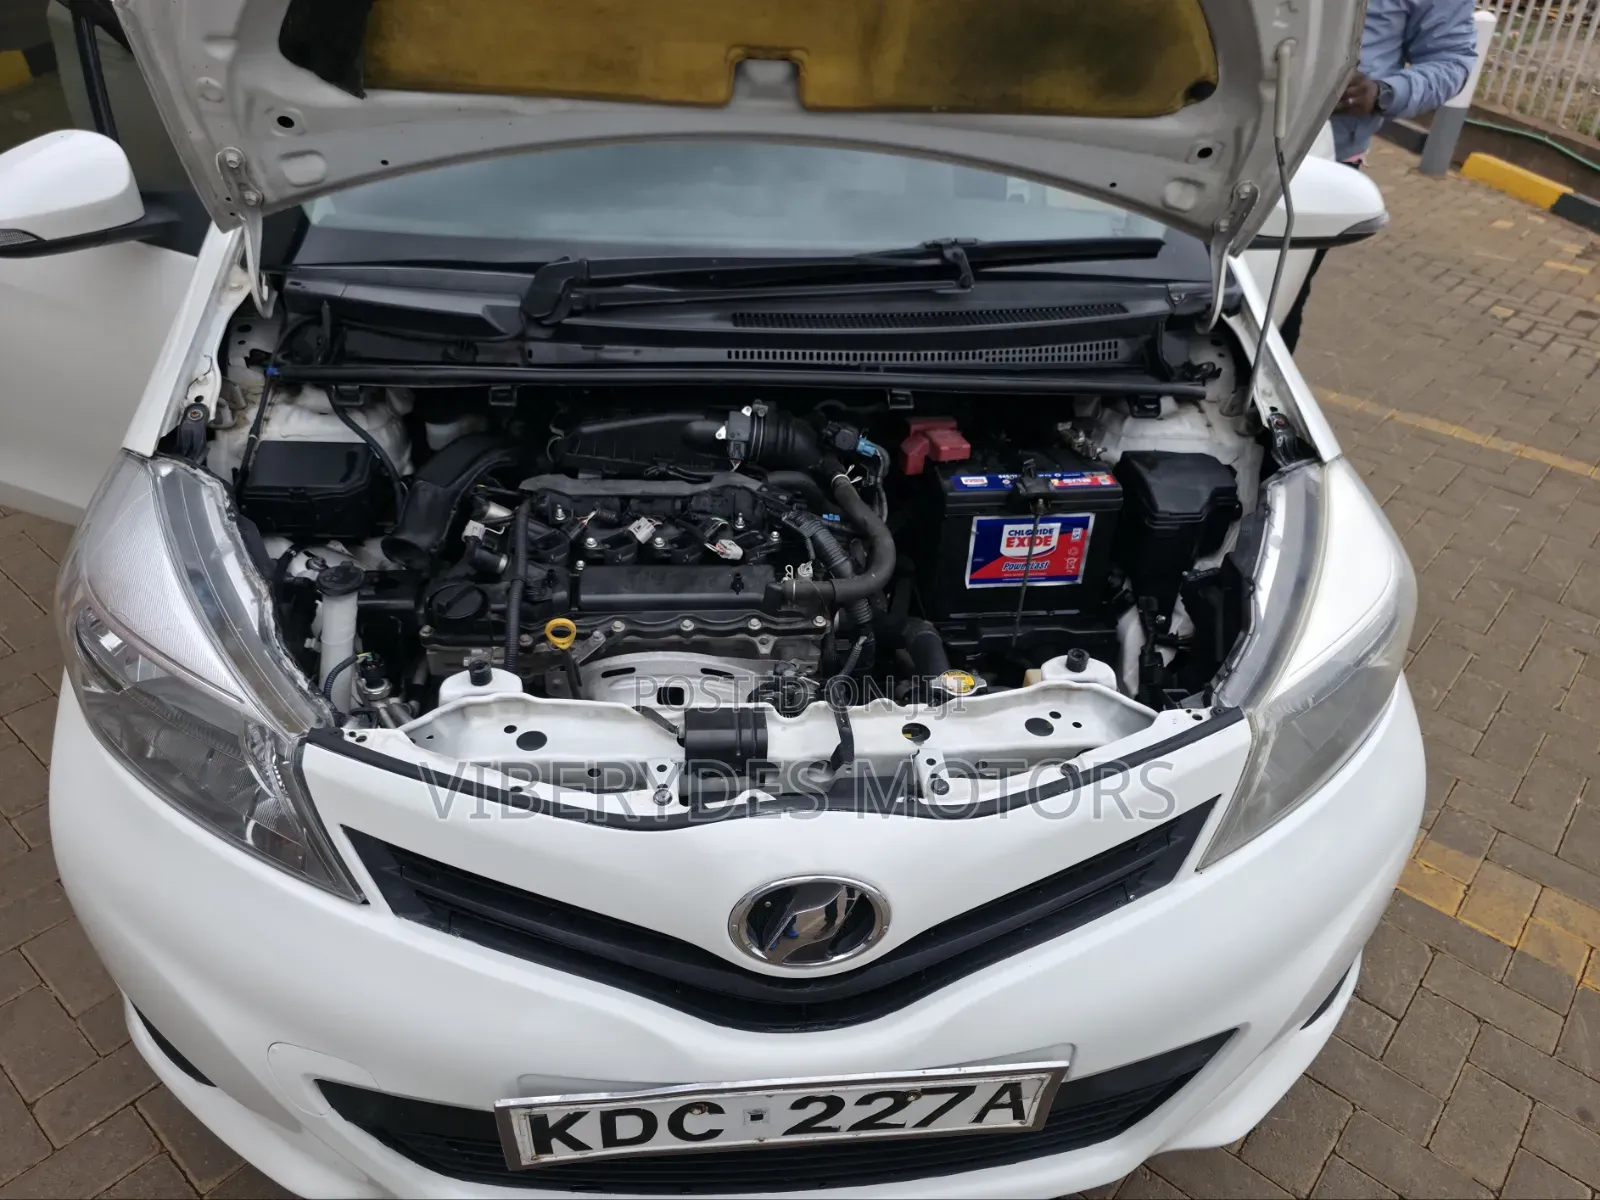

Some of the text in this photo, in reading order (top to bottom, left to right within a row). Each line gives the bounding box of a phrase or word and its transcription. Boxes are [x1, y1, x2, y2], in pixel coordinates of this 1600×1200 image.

[1005, 535, 1053, 548] EXIDE
[530, 1080, 1028, 1155] KDC 227A
